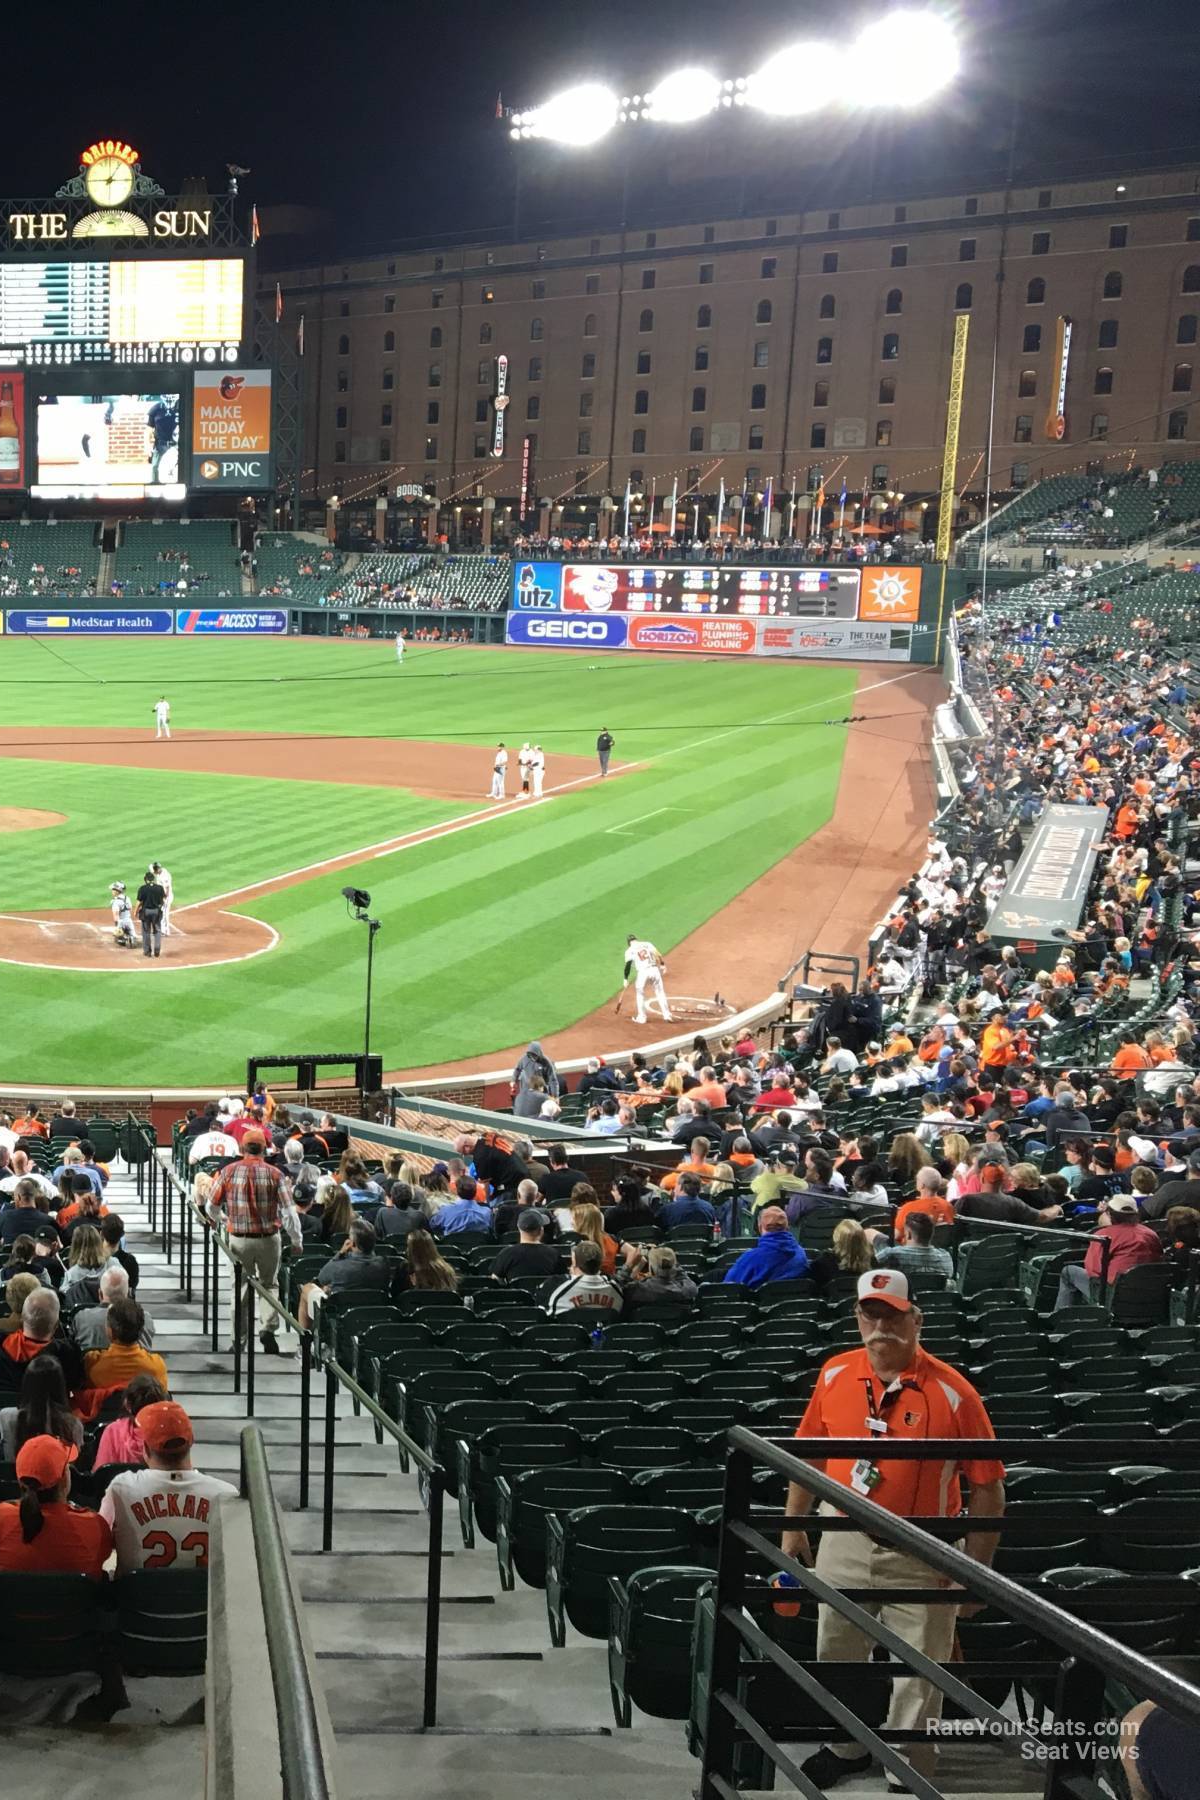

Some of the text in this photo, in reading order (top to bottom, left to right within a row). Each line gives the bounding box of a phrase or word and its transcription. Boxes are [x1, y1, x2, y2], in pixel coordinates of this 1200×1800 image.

[82, 140, 138, 166] ORIOLES
[9, 210, 211, 239] THE SUN
[200, 406, 242, 419] MAKE
[200, 421, 245, 434] TODAY
[200, 436, 227, 449] THE
[221, 462, 261, 477] PNC
[71, 617, 153, 627] MedStar Health
[702, 621, 742, 631] HEATING
[527, 619, 608, 640] GEICO
[702, 630, 749, 640] PLUMBING
[850, 631, 864, 640] THE
[866, 631, 888, 640] TEAM
[638, 631, 698, 644] HORIZON
[701, 639, 742, 649] COOLING
[209, 1144, 225, 1157] 19
